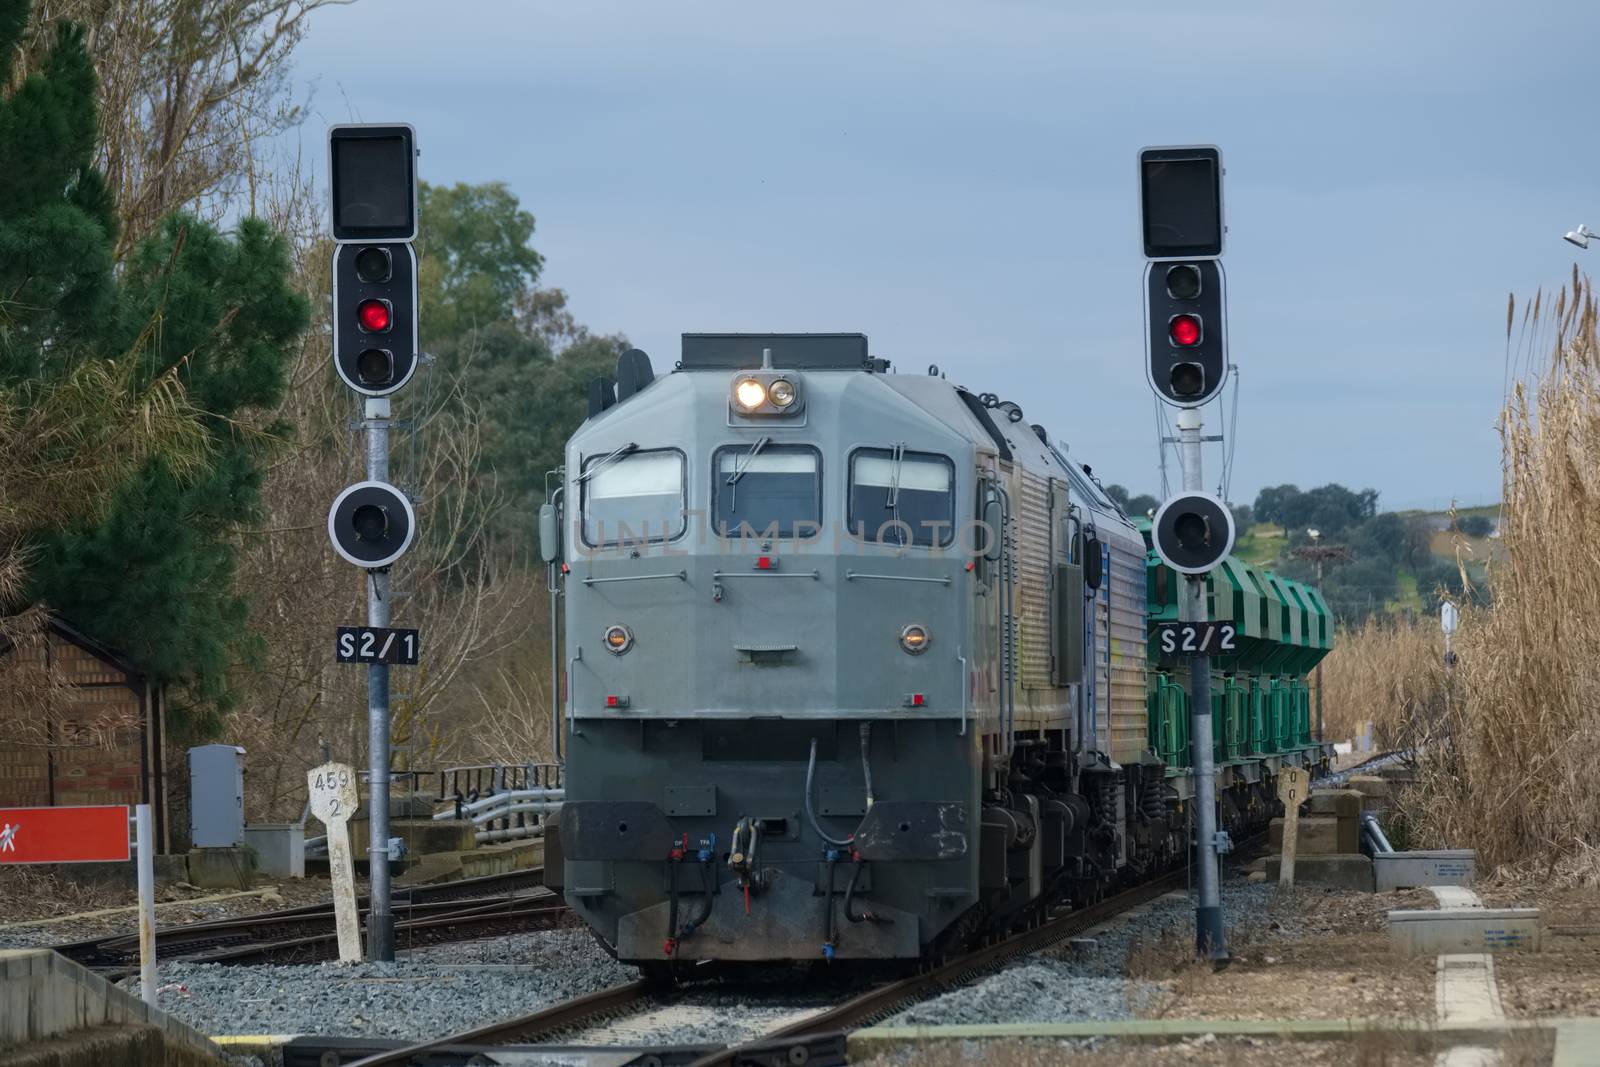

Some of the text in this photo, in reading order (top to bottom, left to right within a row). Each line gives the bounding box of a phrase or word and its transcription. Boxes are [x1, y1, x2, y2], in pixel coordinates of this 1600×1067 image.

[340, 631, 414, 659] S2/1
[1161, 625, 1235, 653] S2/2
[315, 770, 348, 791] 459
[329, 798, 341, 817] 2
